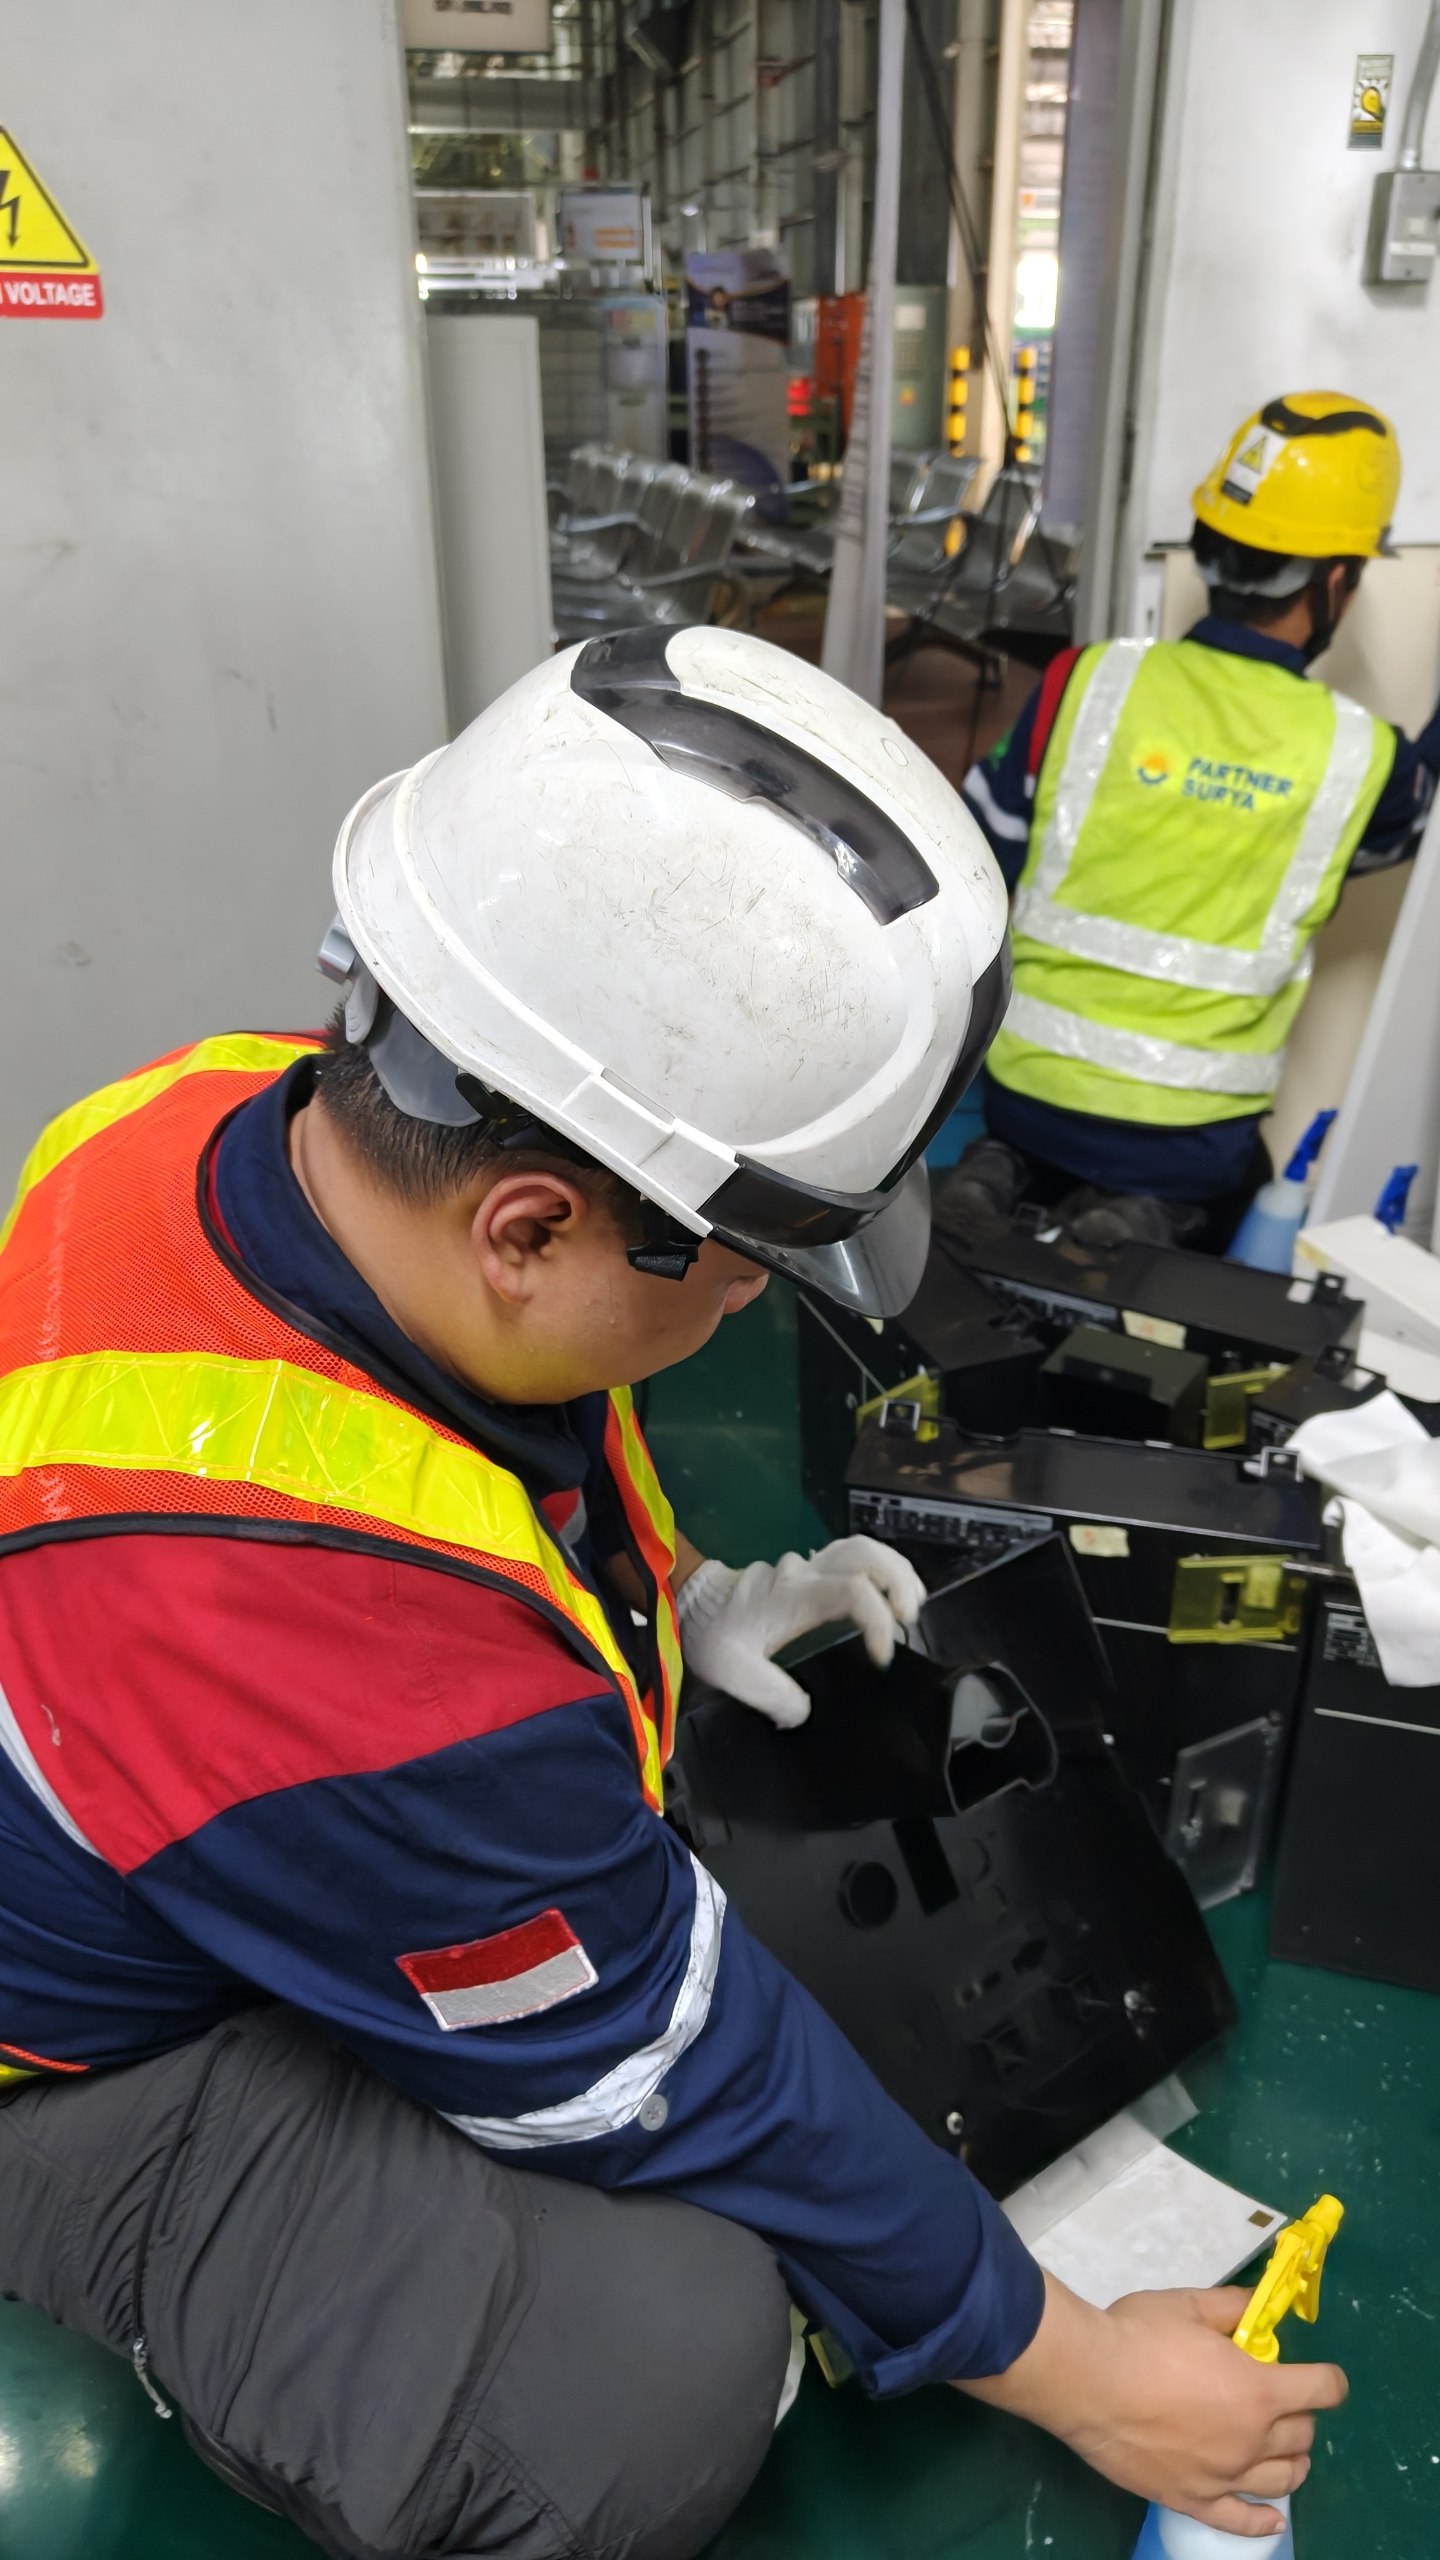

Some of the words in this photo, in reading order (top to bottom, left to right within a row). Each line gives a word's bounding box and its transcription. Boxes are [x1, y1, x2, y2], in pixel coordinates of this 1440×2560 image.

[4, 281, 96, 306] VOLTAGE
[1189, 757, 1293, 796] PARTNER
[1182, 779, 1255, 811] SURYA
